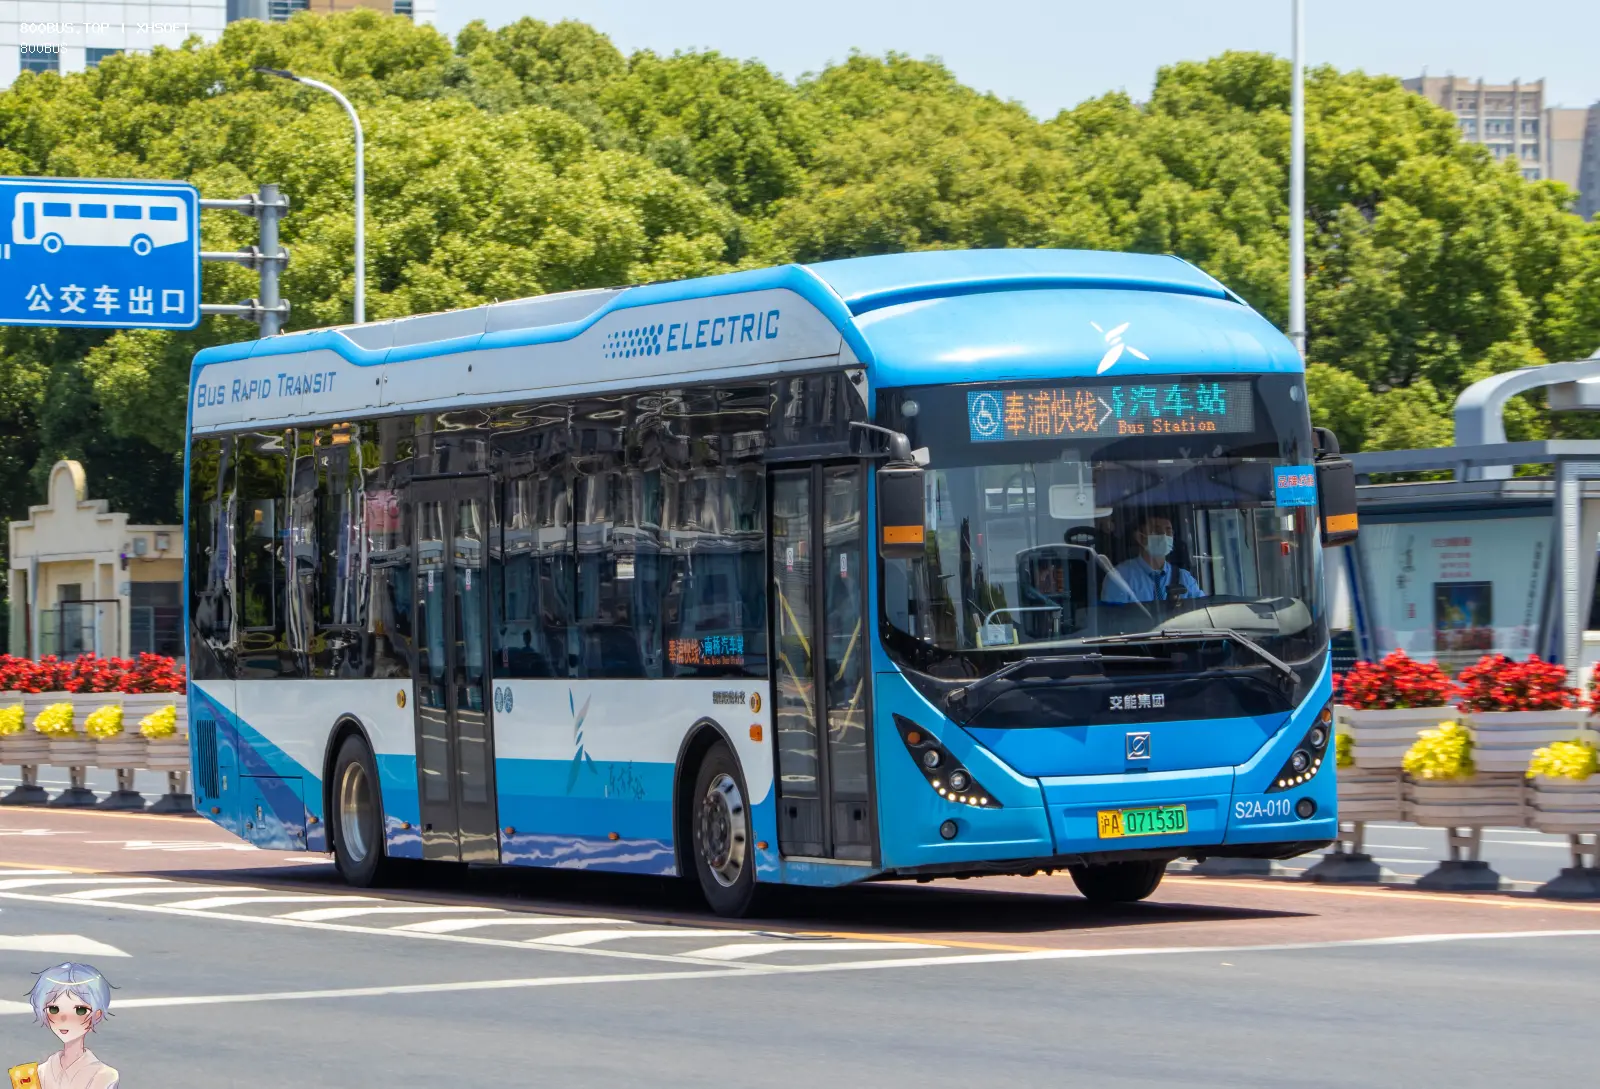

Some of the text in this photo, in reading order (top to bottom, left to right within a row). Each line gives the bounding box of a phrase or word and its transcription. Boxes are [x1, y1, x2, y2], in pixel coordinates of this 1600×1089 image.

[25, 284, 186, 316] 公交车出口
[666, 309, 780, 352] ELECTRIC
[1004, 389, 1099, 436] 奉浦快线
[1118, 416, 1216, 434] Bus Station
[1109, 693, 1165, 710] 交能集团
[1234, 798, 1291, 819] S2A-010
[1100, 809, 1185, 834] 沪A 07153D
